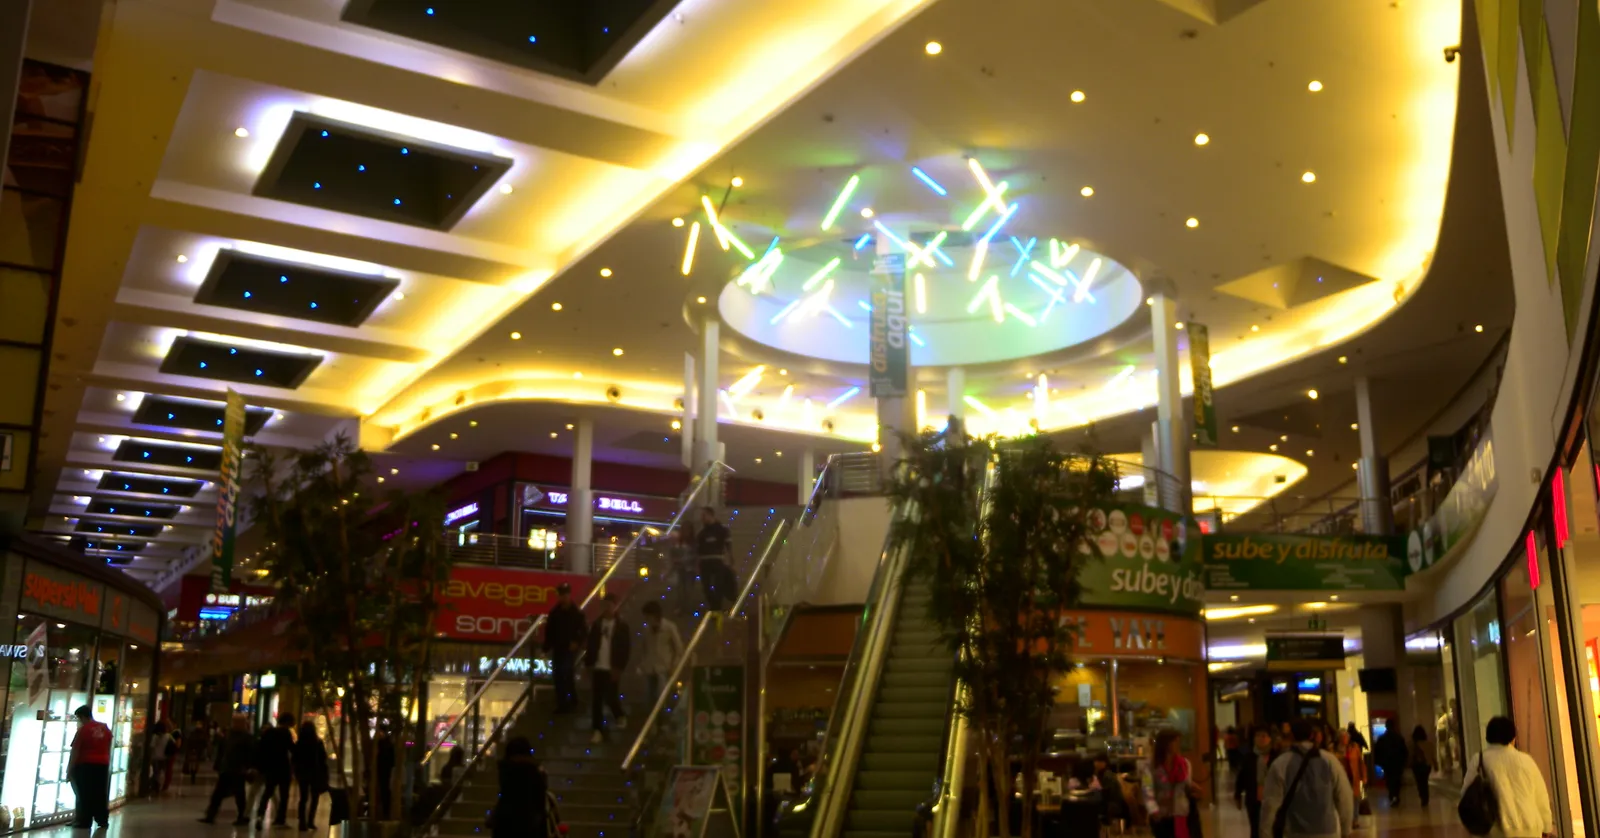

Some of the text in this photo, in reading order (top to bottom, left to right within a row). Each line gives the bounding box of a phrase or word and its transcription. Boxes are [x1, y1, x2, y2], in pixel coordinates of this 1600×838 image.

[882, 288, 907, 349] aquí
[547, 491, 643, 512] TA BELL
[1213, 536, 1272, 560] sube
[1276, 543, 1291, 565] y
[1295, 536, 1387, 560] disfruta
[1110, 562, 1168, 596] sube
[1170, 575, 1182, 604] y
